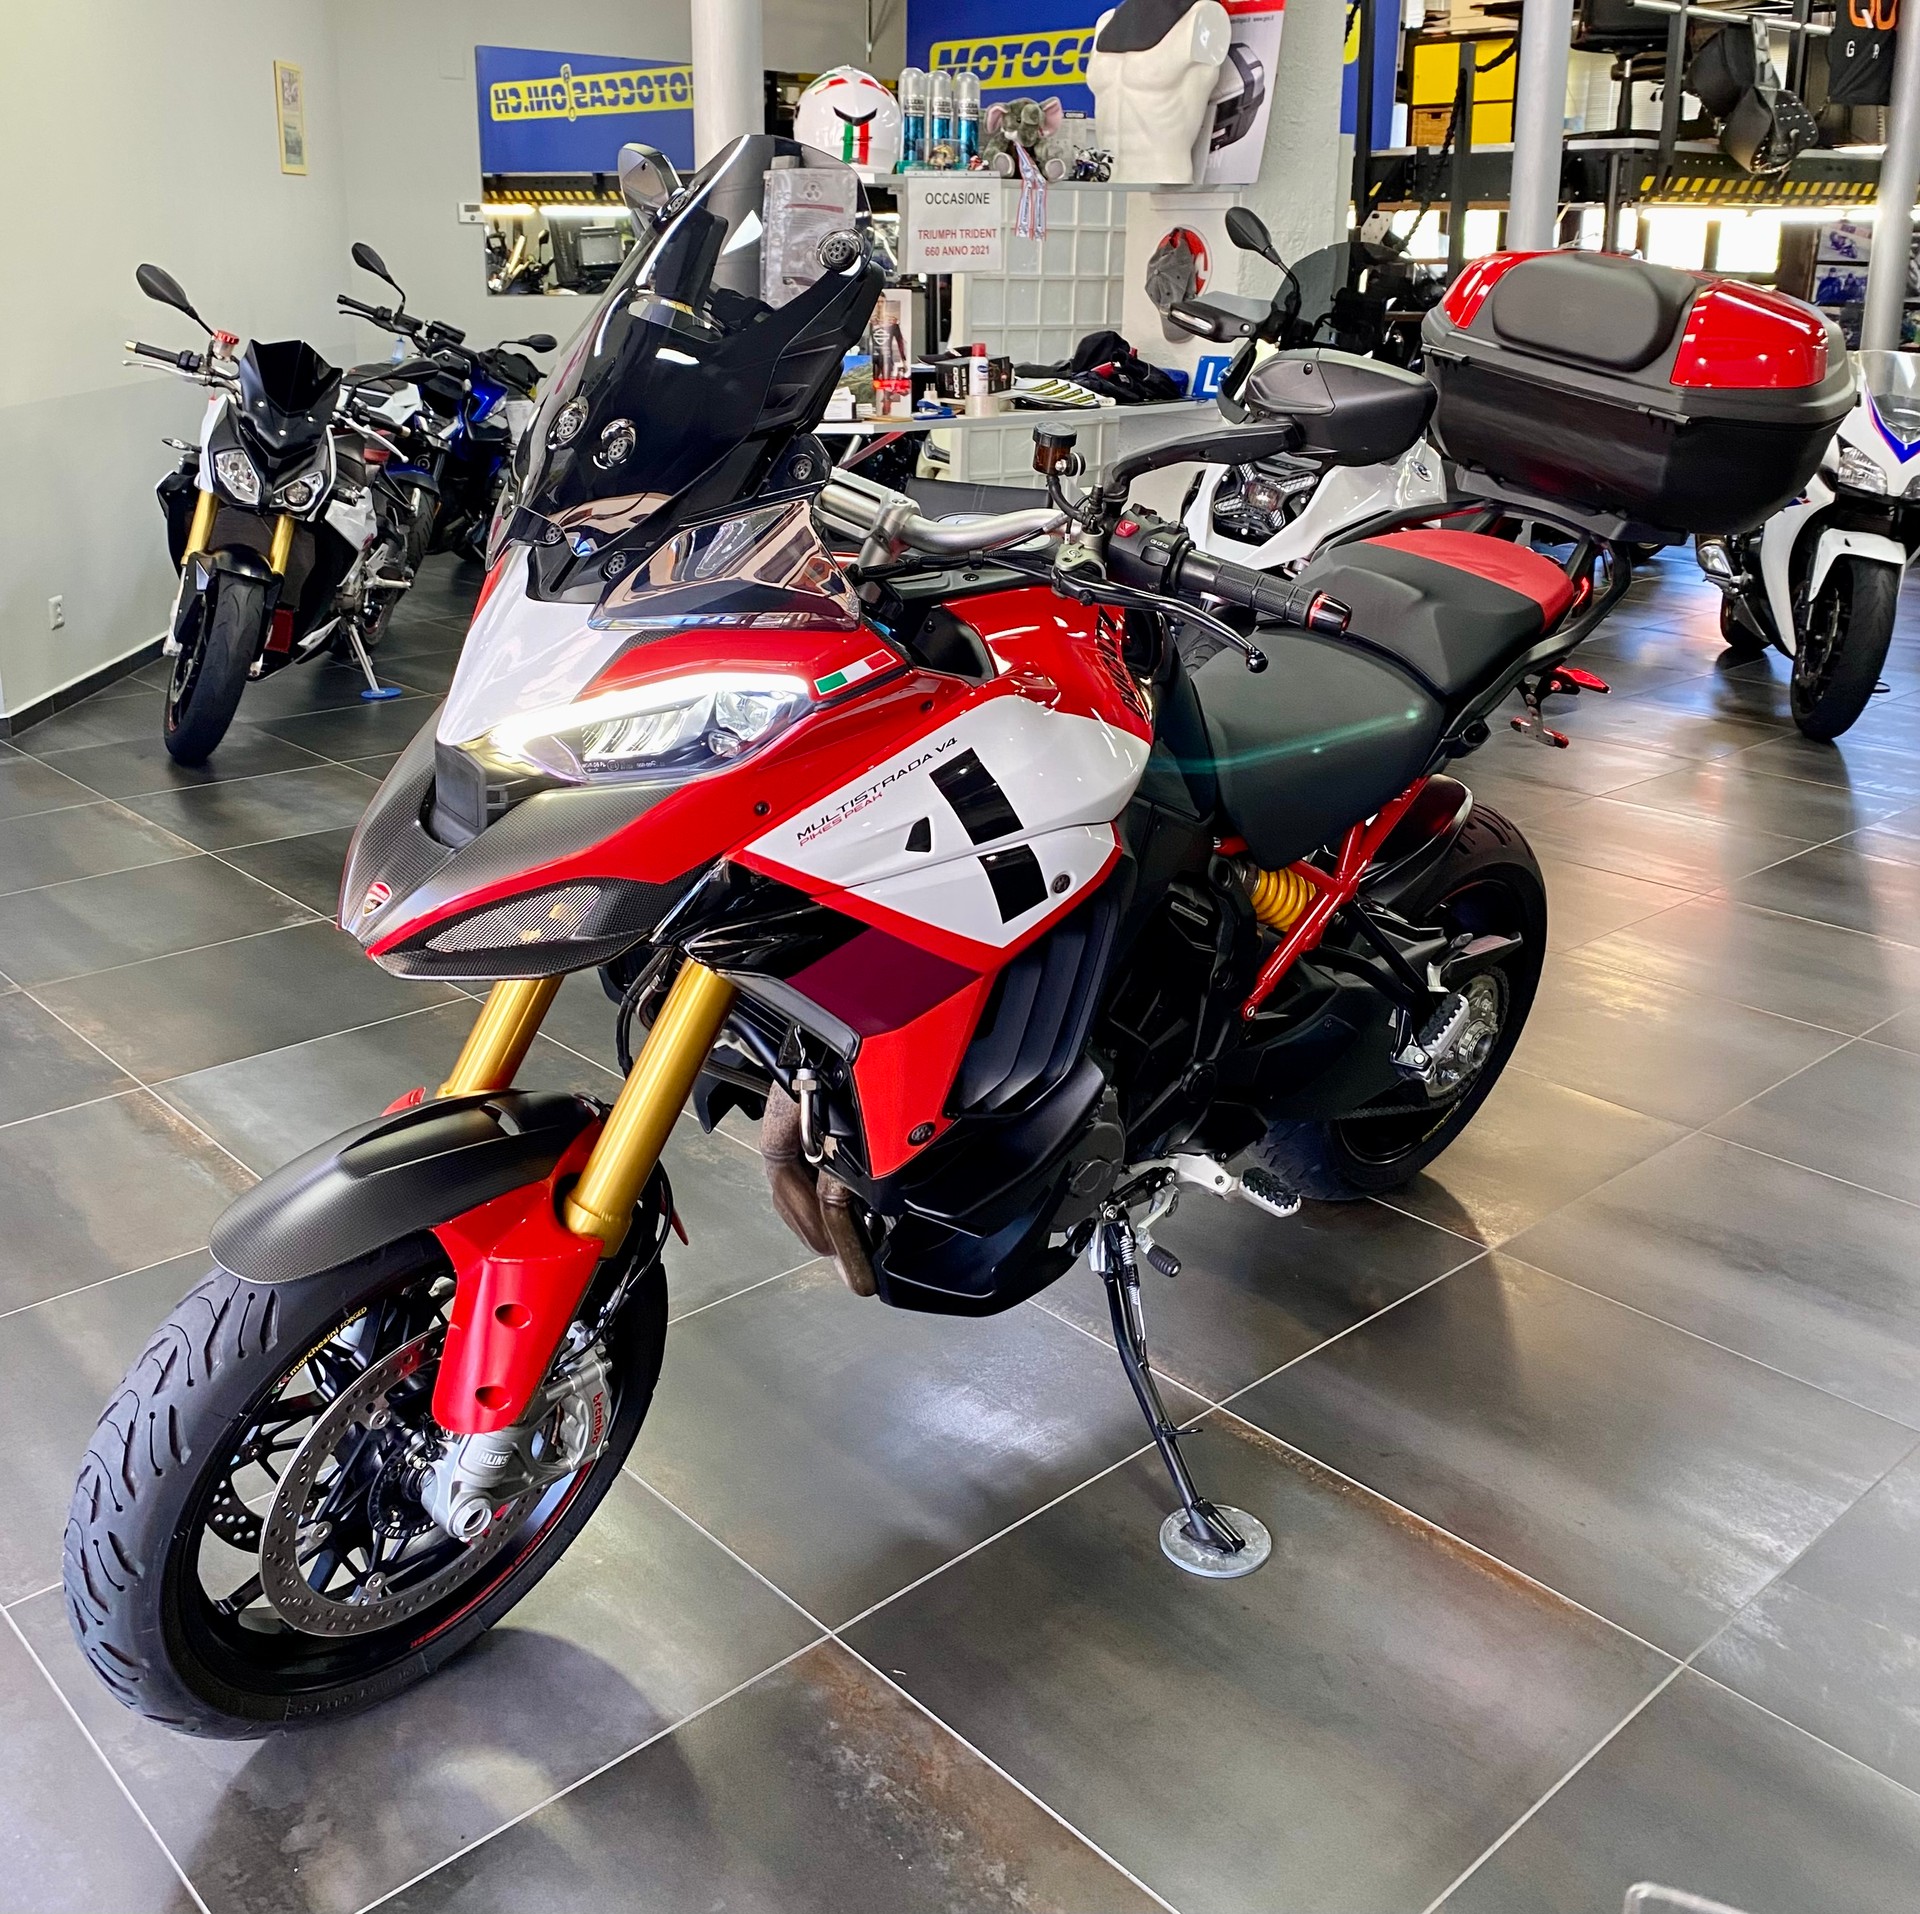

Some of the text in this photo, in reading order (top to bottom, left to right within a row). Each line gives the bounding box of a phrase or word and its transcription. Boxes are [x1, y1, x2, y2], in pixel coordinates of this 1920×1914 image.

[925, 192, 990, 205] OCCASIONE
[918, 228, 997, 240] TRIUMPH TRIDENT
[925, 245, 990, 257] 660 ANNO 2021
[1202, 362, 1219, 393] L
[797, 737, 958, 840] MULTISTRADA V4
[799, 791, 883, 847] PIKES PEAK
[289, 1306, 368, 1376] marchesini FORGED
[591, 1391, 603, 1444] brembo
[475, 1451, 509, 1466] HLINS
